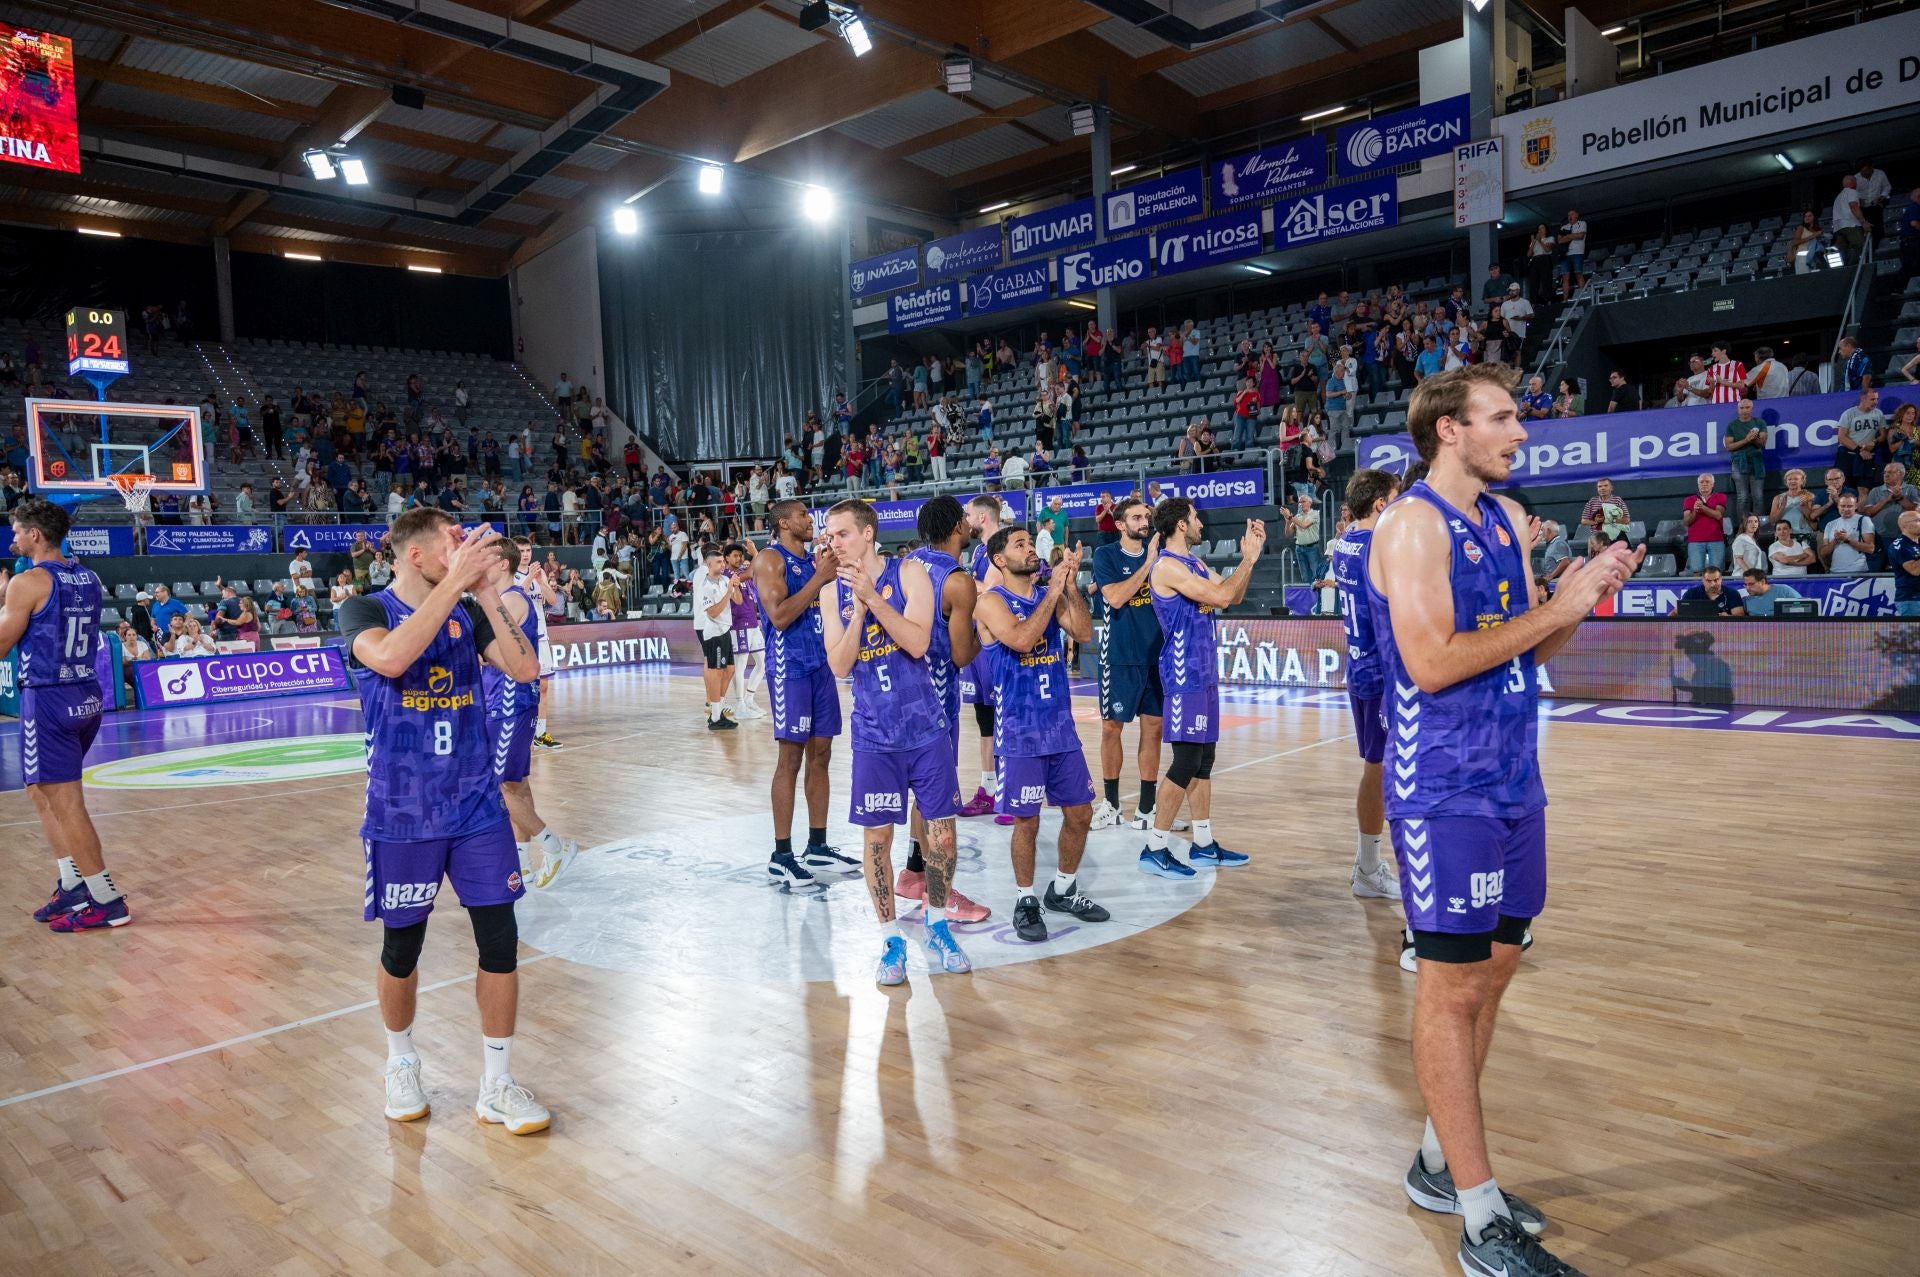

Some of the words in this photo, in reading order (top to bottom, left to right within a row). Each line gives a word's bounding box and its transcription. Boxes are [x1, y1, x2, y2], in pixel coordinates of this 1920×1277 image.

[1582, 113, 1687, 156] Pabellón
[1700, 75, 1831, 128] Municipal
[1846, 67, 1883, 95] de
[1386, 117, 1427, 135] carpintería
[1238, 147, 1300, 177] Mármoles
[1458, 141, 1499, 161] RIFA
[1264, 165, 1314, 187] Palencia
[1138, 186, 1185, 205] Diputación
[1230, 194, 1254, 204] SOMOS
[1256, 180, 1307, 198] FABRICANTES
[1138, 207, 1151, 217] DE
[1153, 195, 1198, 213] PALENCIA
[1294, 192, 1390, 235] alser
[1192, 222, 1259, 252] nirosa
[1323, 217, 1385, 237] INSTALACIONES
[867, 259, 917, 281] INMAPA
[949, 252, 1000, 269] ORTOPEDIA
[994, 267, 1046, 293] GABAN
[1076, 257, 1143, 287] SUEÑO
[895, 286, 950, 312] Peñafría
[1001, 290, 1019, 300] MODA
[1019, 285, 1043, 296] HOMBRE
[89, 311, 113, 325] 0.0
[83, 333, 122, 359] 24
[1854, 418, 1879, 432] GAP
[1508, 432, 1608, 476] opal
[1629, 411, 1840, 468] palnc
[1186, 480, 1256, 500] cofersa
[877, 509, 914, 520] nkitchen
[1129, 597, 1151, 607] agro
[64, 616, 92, 658] 15
[1221, 627, 1250, 647] LA
[551, 637, 671, 668] PALENTINA
[1019, 652, 1060, 667] agropl
[1216, 641, 1307, 683] TAÑA
[206, 661, 284, 683] Grupo
[290, 653, 331, 674] CFI
[876, 664, 892, 692] 5
[211, 683, 264, 694] Ciberseguridad
[265, 682, 269, 690] y
[270, 679, 305, 688] Protección
[1038, 673, 1051, 700] 2
[402, 690, 474, 712] agropal
[434, 720, 453, 756] 8
[864, 792, 902, 813] gaza
[1021, 785, 1045, 804] gaza
[385, 882, 439, 910] gaza
[1470, 869, 1505, 909] gaz
